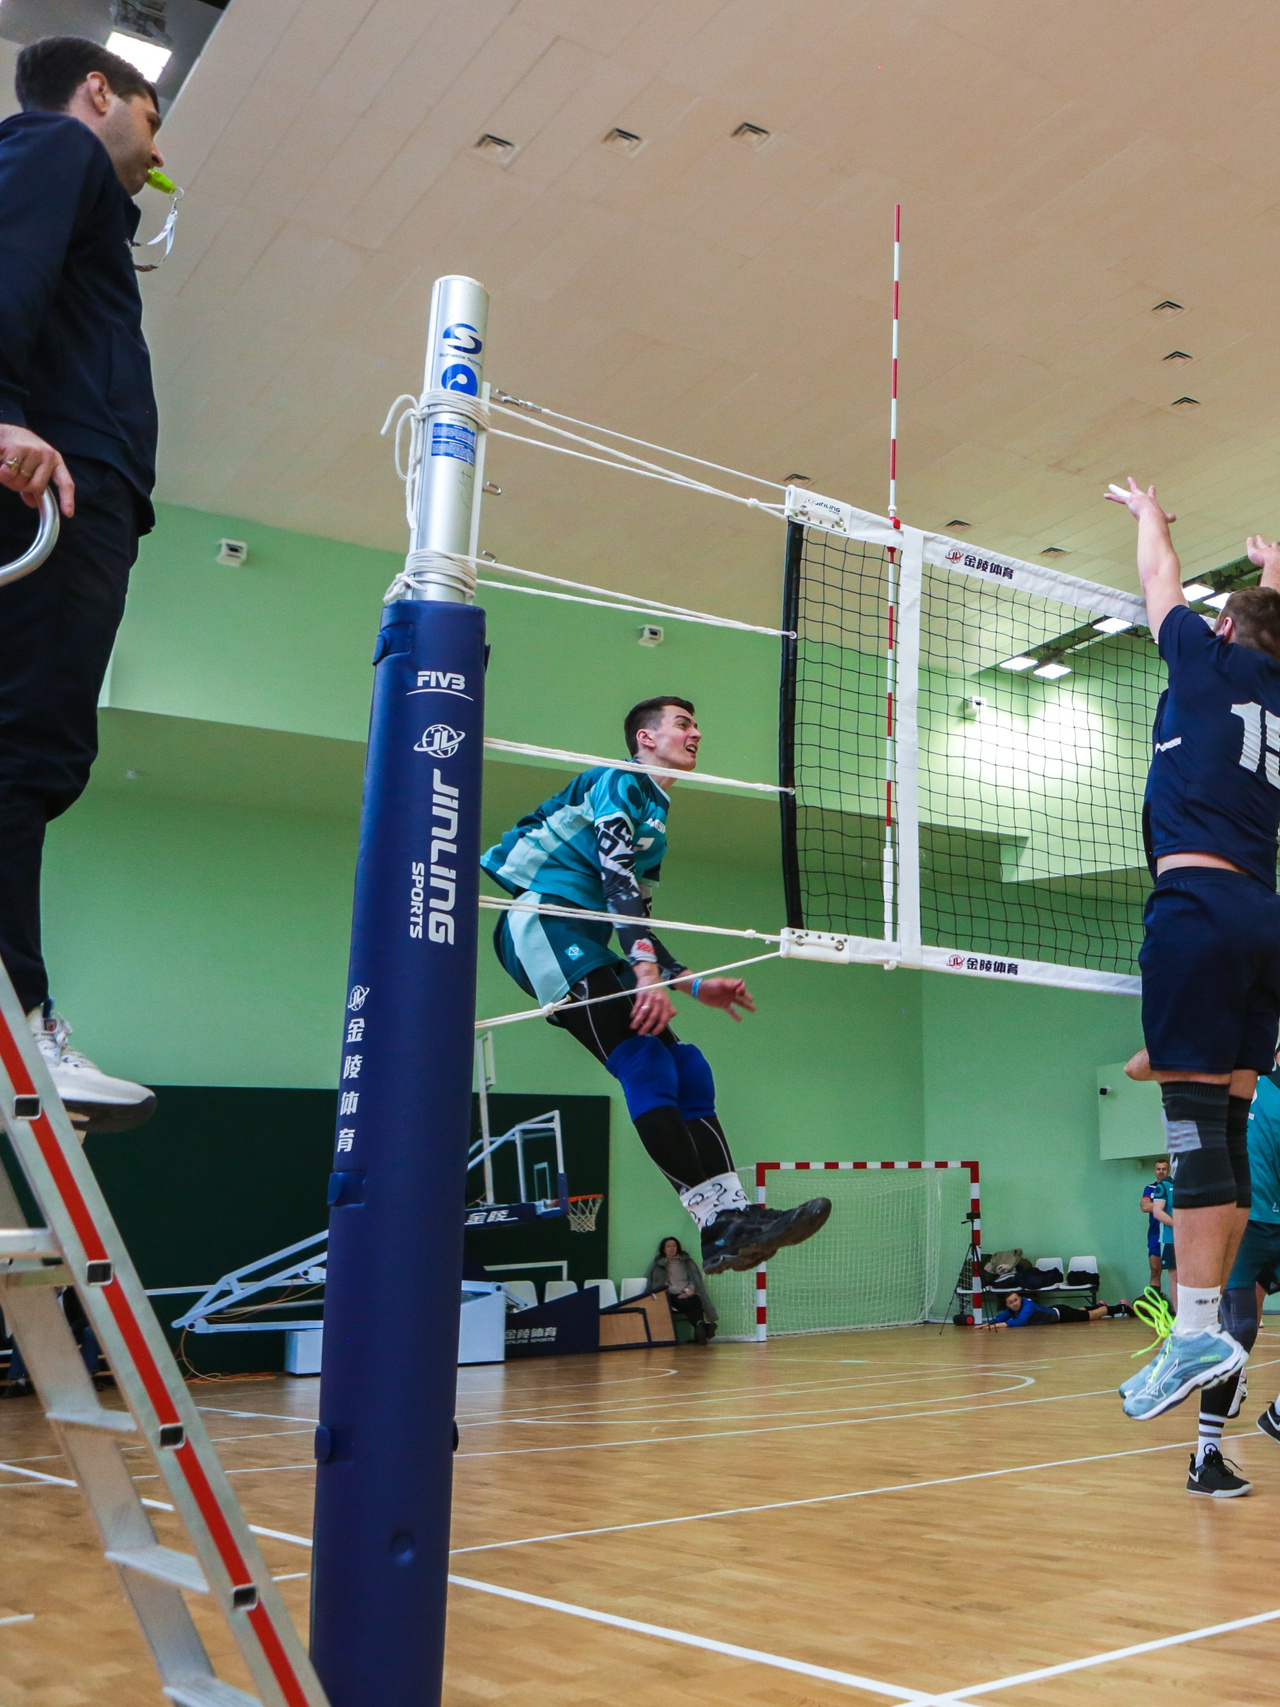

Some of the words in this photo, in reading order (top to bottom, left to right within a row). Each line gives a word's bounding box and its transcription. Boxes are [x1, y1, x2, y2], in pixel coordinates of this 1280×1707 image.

[964, 554, 1014, 580] 金陵体育
[417, 670, 466, 690] FIVB
[410, 861, 425, 940] SPORTS
[966, 958, 1019, 976] 金陵体育
[337, 1017, 365, 1153] 金陵体育
